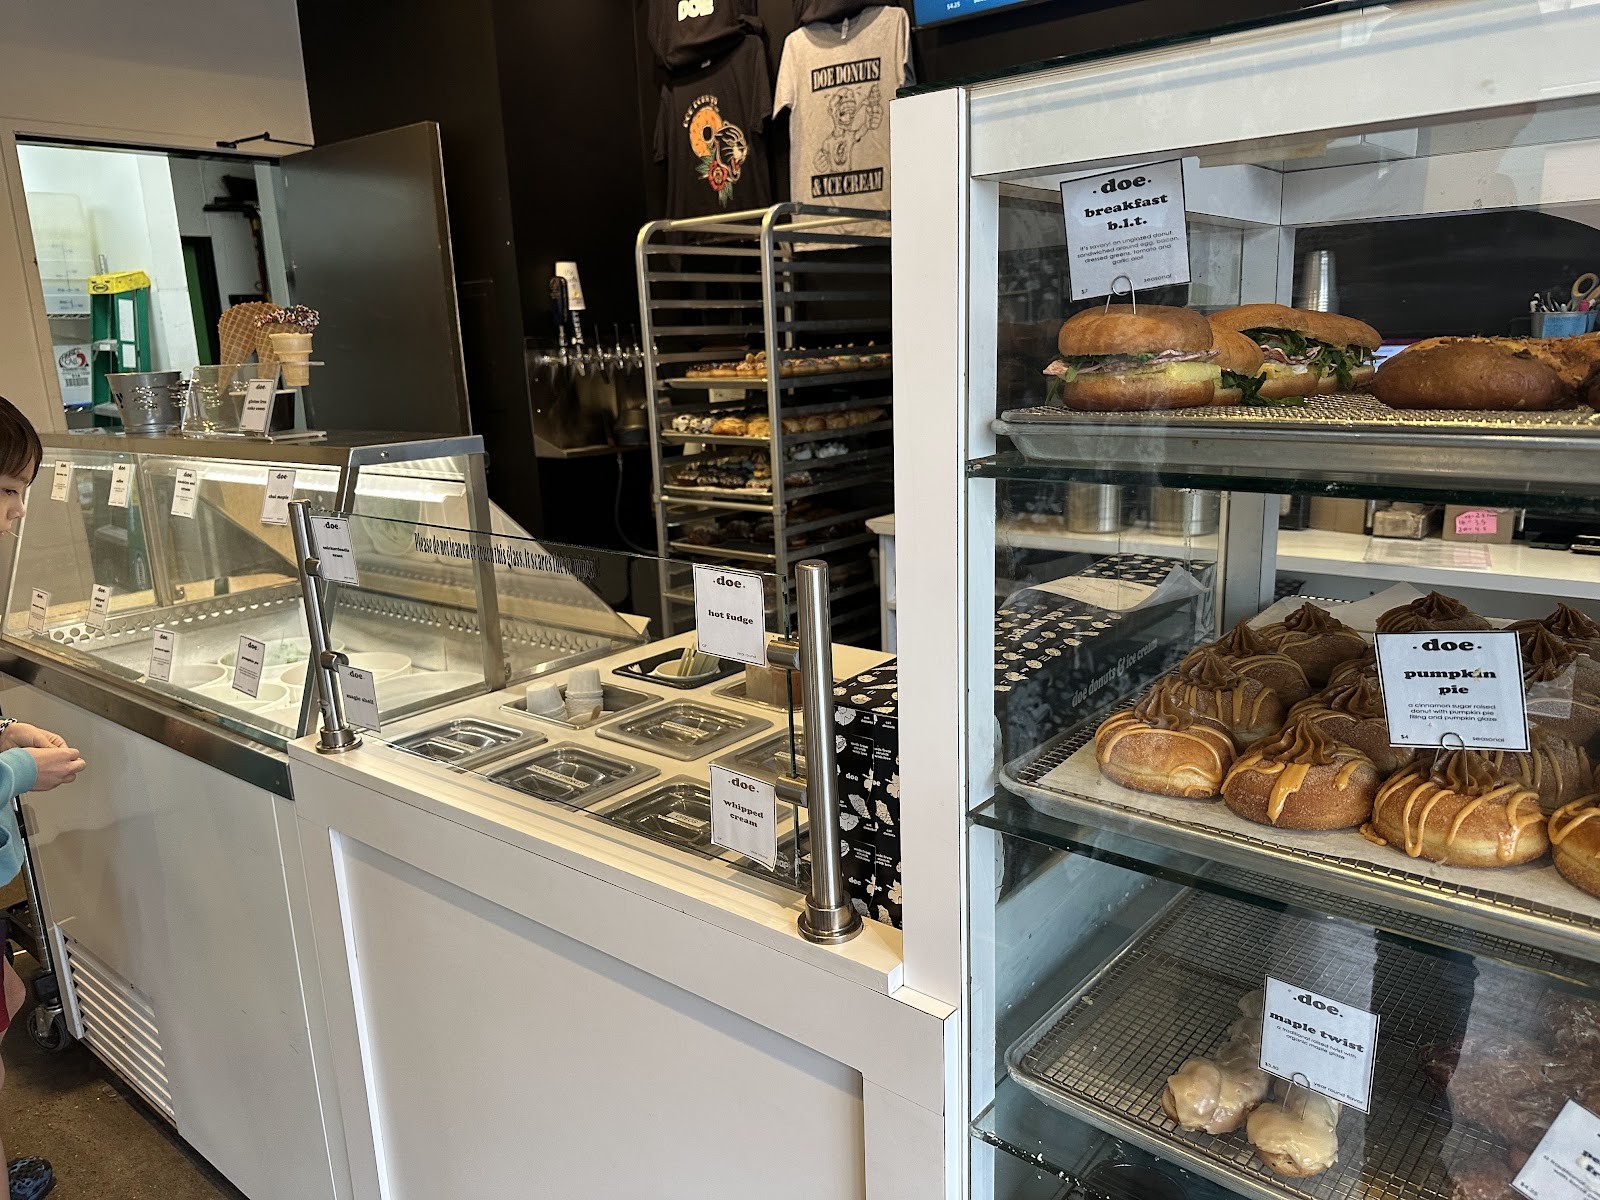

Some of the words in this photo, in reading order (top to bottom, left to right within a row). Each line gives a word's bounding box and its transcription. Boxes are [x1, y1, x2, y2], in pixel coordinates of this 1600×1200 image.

[813, 69, 835, 90] DOE
[836, 60, 880, 85] DONUTS
[813, 178, 823, 196] &
[823, 175, 842, 195] ICE
[843, 171, 882, 193] CREAM
[1084, 194, 1168, 217] breakfast
[1107, 216, 1147, 230] b.l.t.
[1122, 234, 1152, 244] unglazed
[1153, 230, 1172, 238] donut
[1077, 248, 1115, 258] sandwiched
[1116, 243, 1139, 251] around
[1133, 246, 1157, 254] tomato
[1143, 273, 1172, 283] seasonal
[414, 532, 432, 554] Please
[494, 544, 507, 565] this
[531, 552, 553, 572] scares
[708, 610, 724, 618] hot
[726, 613, 754, 625] fudge
[1072, 688, 1088, 707] doe
[1088, 667, 1116, 695] donuts
[1438, 685, 1469, 695] pie
[723, 800, 764, 818] whipped
[730, 813, 758, 827] cream
[1269, 1011, 1317, 1035] maple
[1319, 1030, 1365, 1053] twist
[1286, 1034, 1308, 1046] organic
[1309, 1043, 1328, 1053] maple
[1329, 1045, 1343, 1054] twist
